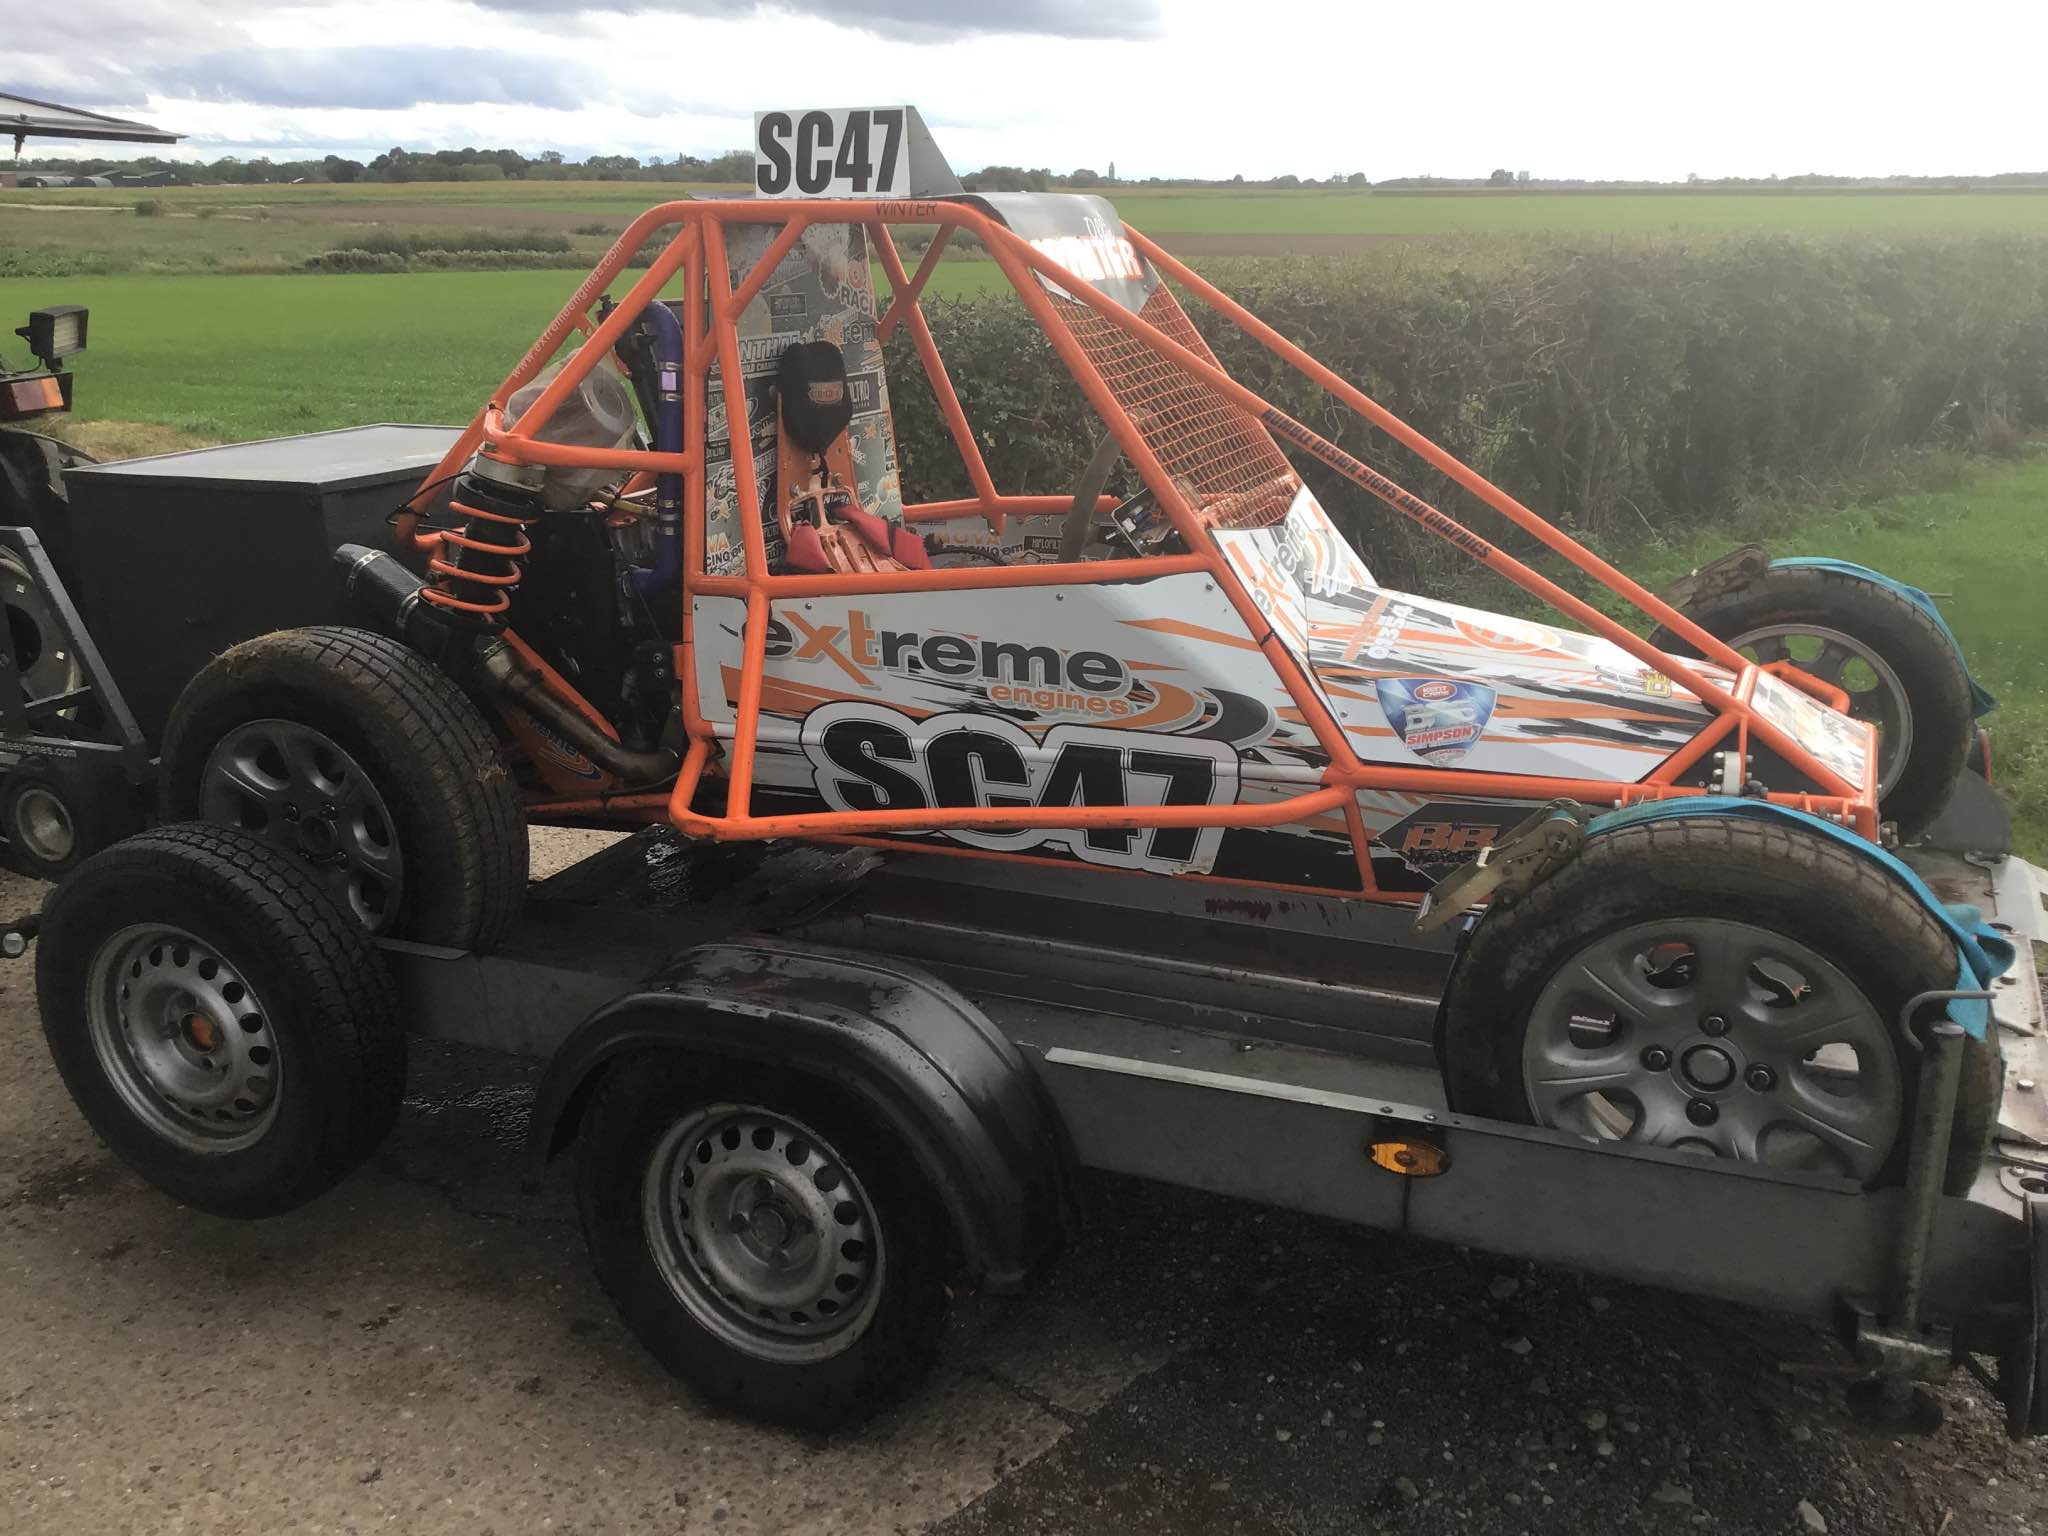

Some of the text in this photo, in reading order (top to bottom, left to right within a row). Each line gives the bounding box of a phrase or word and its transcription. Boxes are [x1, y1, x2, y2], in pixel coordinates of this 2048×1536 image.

[757, 109, 904, 196] SC47
[876, 201, 938, 217] WINTER
[1262, 408, 1492, 559] HUMBLE DESIGN SIGNS AND GRAPHICS
[743, 610, 1127, 691] extreme
[990, 681, 1132, 716] engines
[1406, 726, 1472, 745] SIMPSON
[822, 719, 1217, 862] SC47
